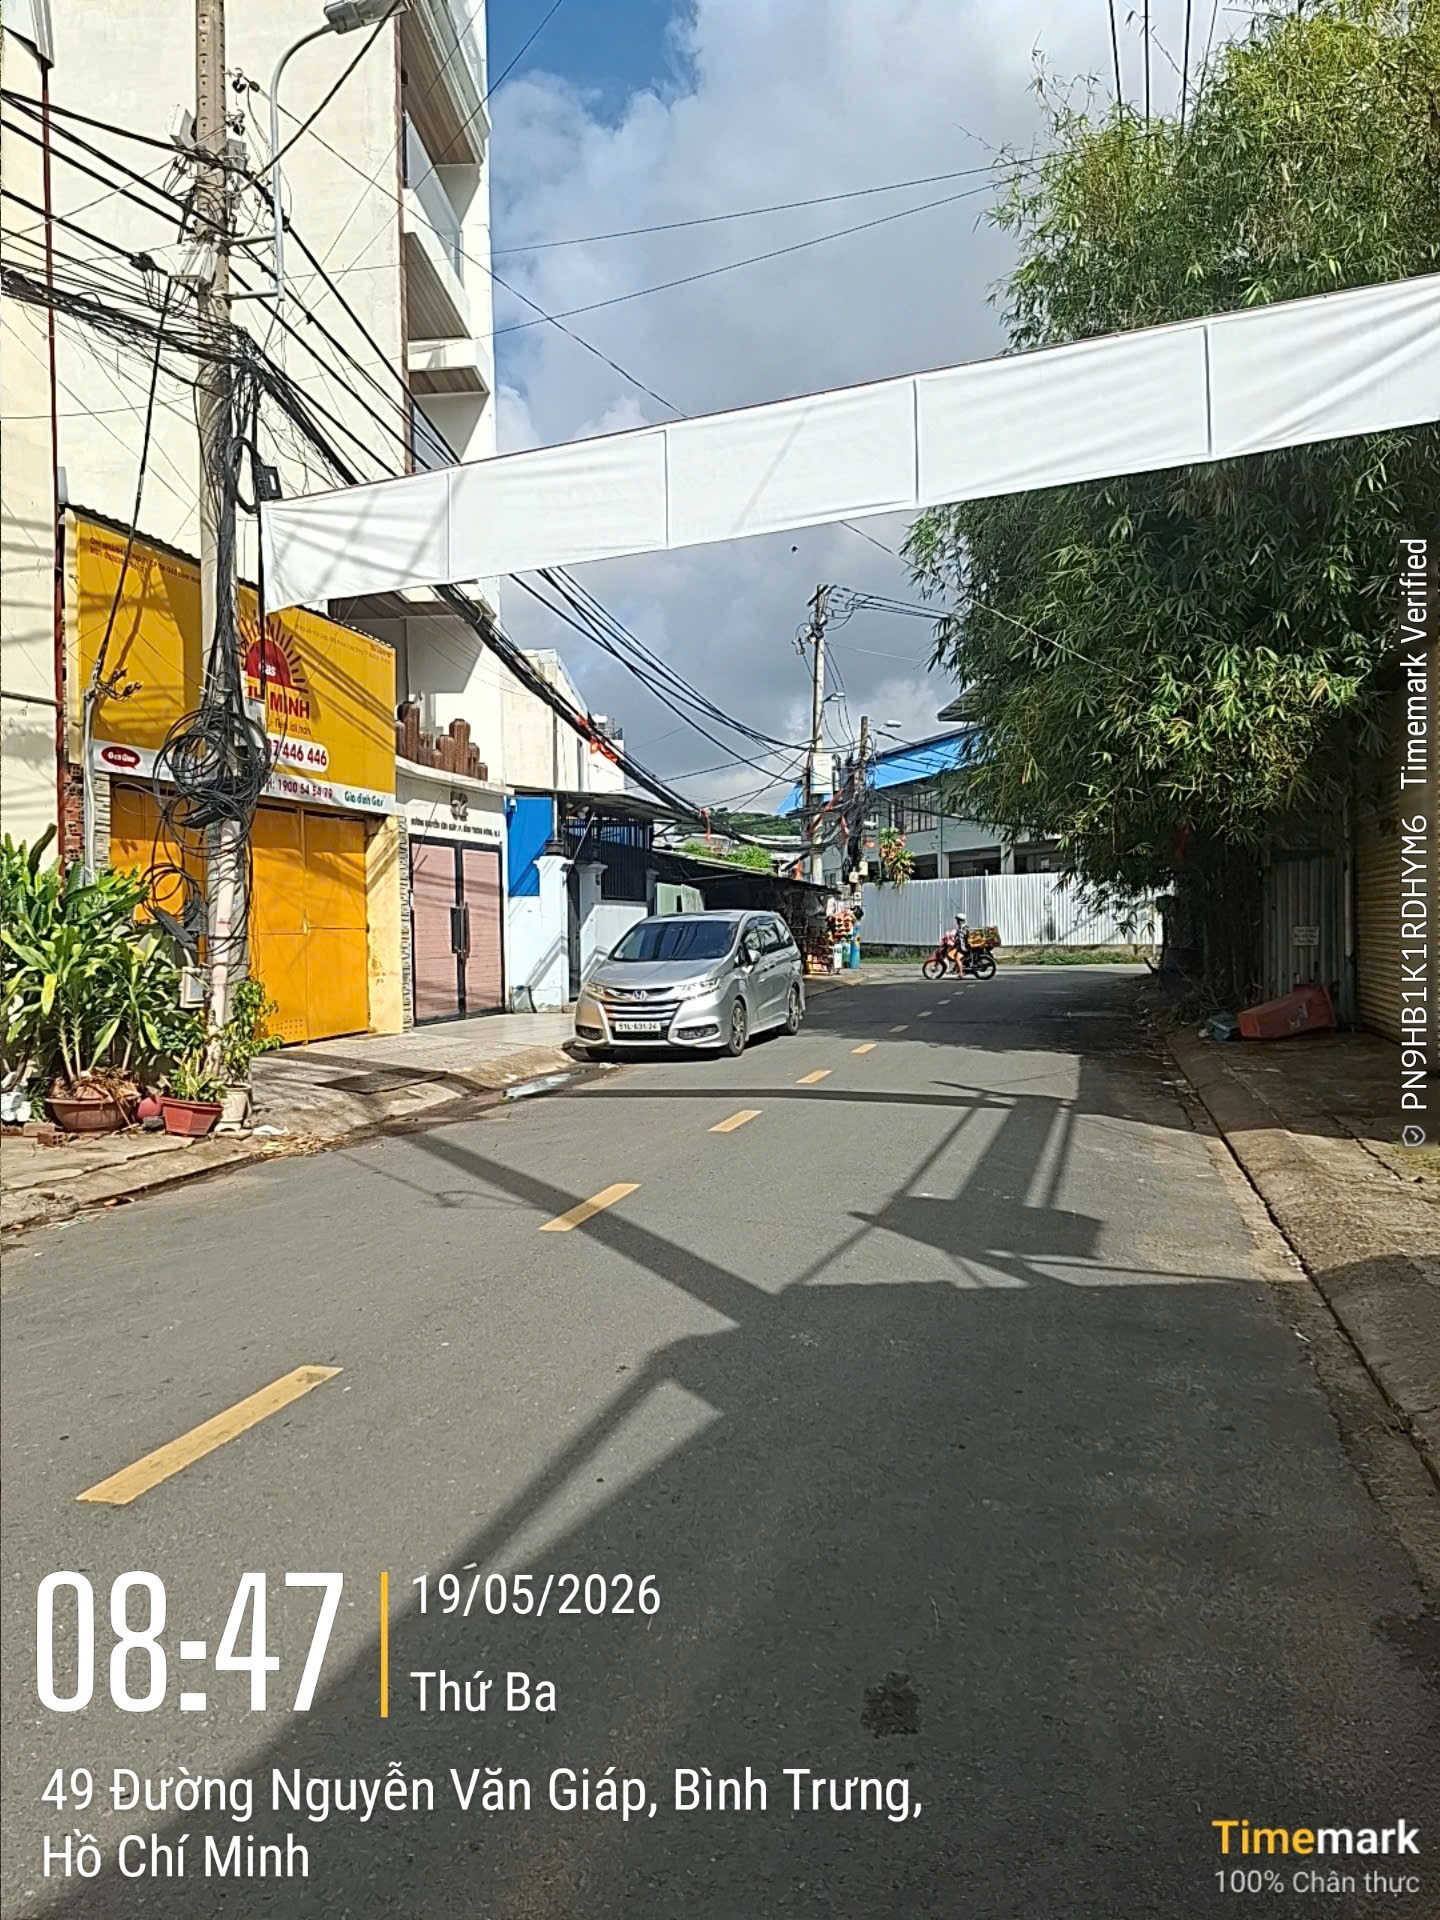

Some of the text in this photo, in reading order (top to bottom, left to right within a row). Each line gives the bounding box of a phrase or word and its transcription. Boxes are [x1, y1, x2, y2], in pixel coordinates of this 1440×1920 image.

[270, 691, 310, 719] MINH
[283, 744, 304, 762] 446
[308, 746, 327, 766] 446
